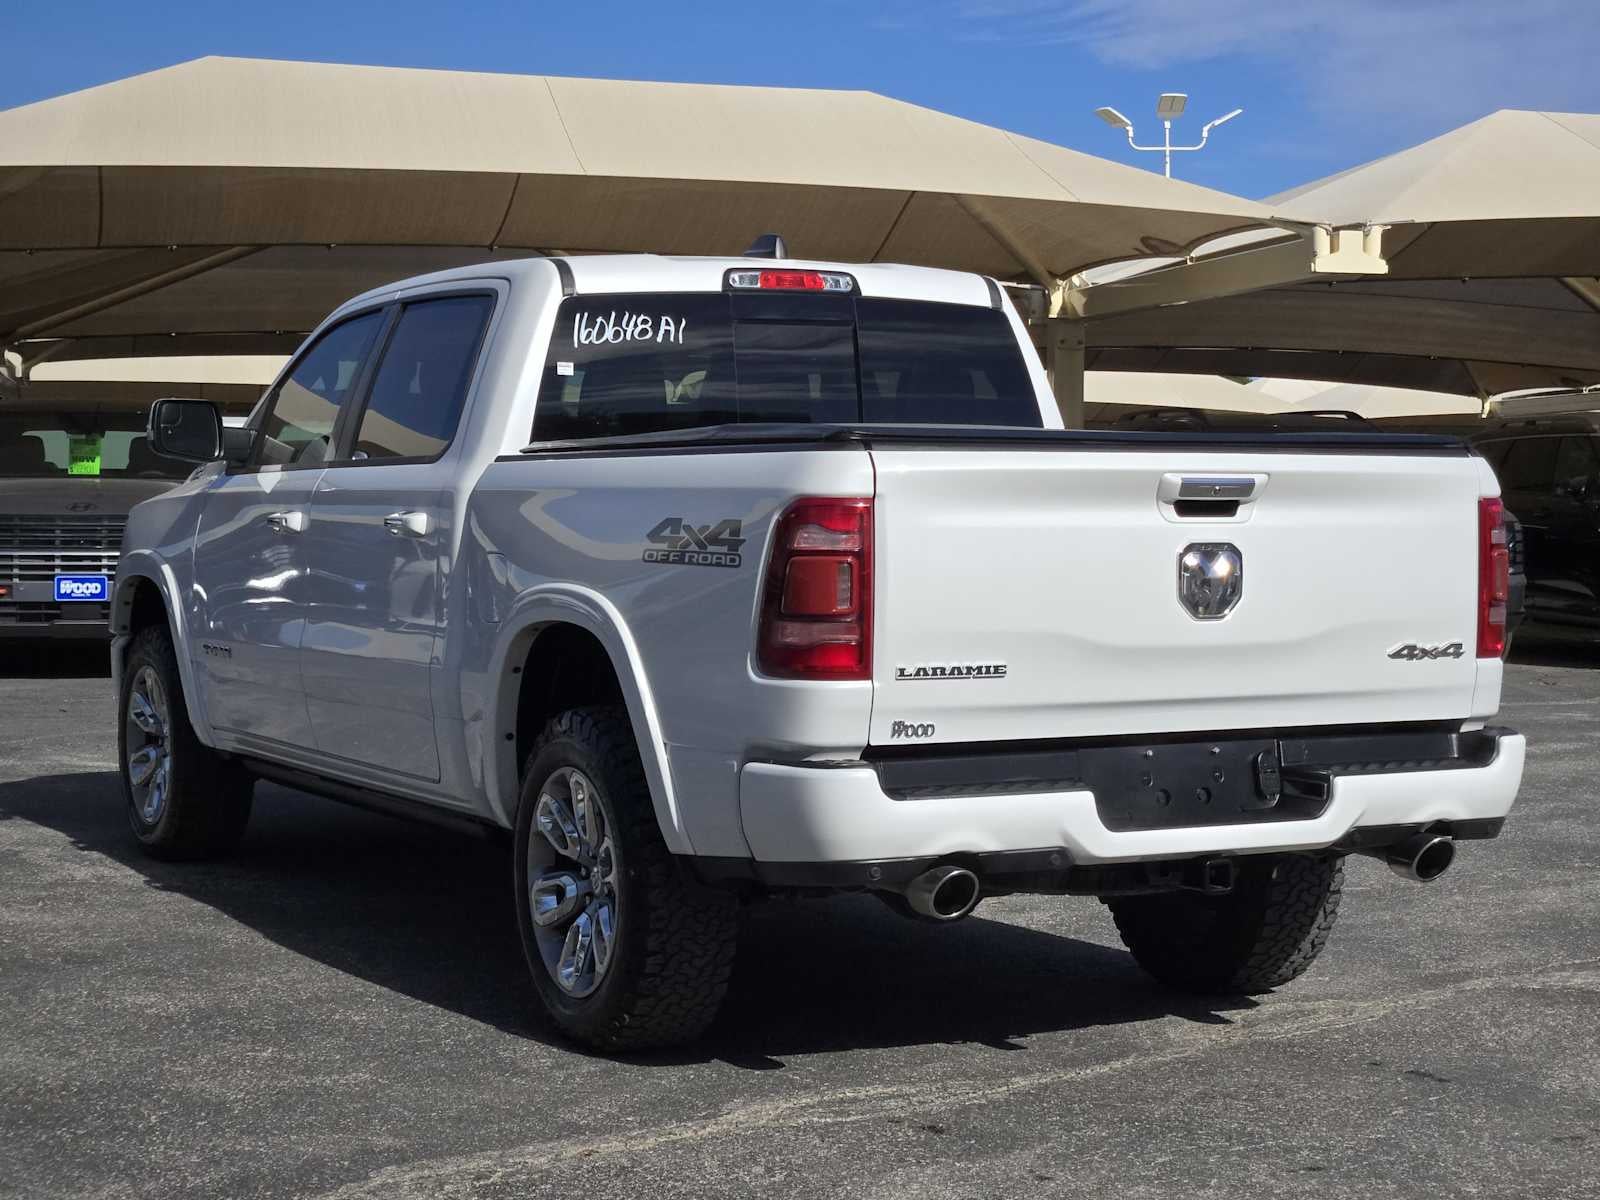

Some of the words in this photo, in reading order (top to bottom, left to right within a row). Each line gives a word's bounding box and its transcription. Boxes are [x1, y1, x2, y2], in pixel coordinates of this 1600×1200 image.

[644, 550, 681, 562] OFF
[684, 552, 741, 566] ROAD
[60, 580, 101, 594] WOOD
[896, 664, 1008, 678] LARAMIE
